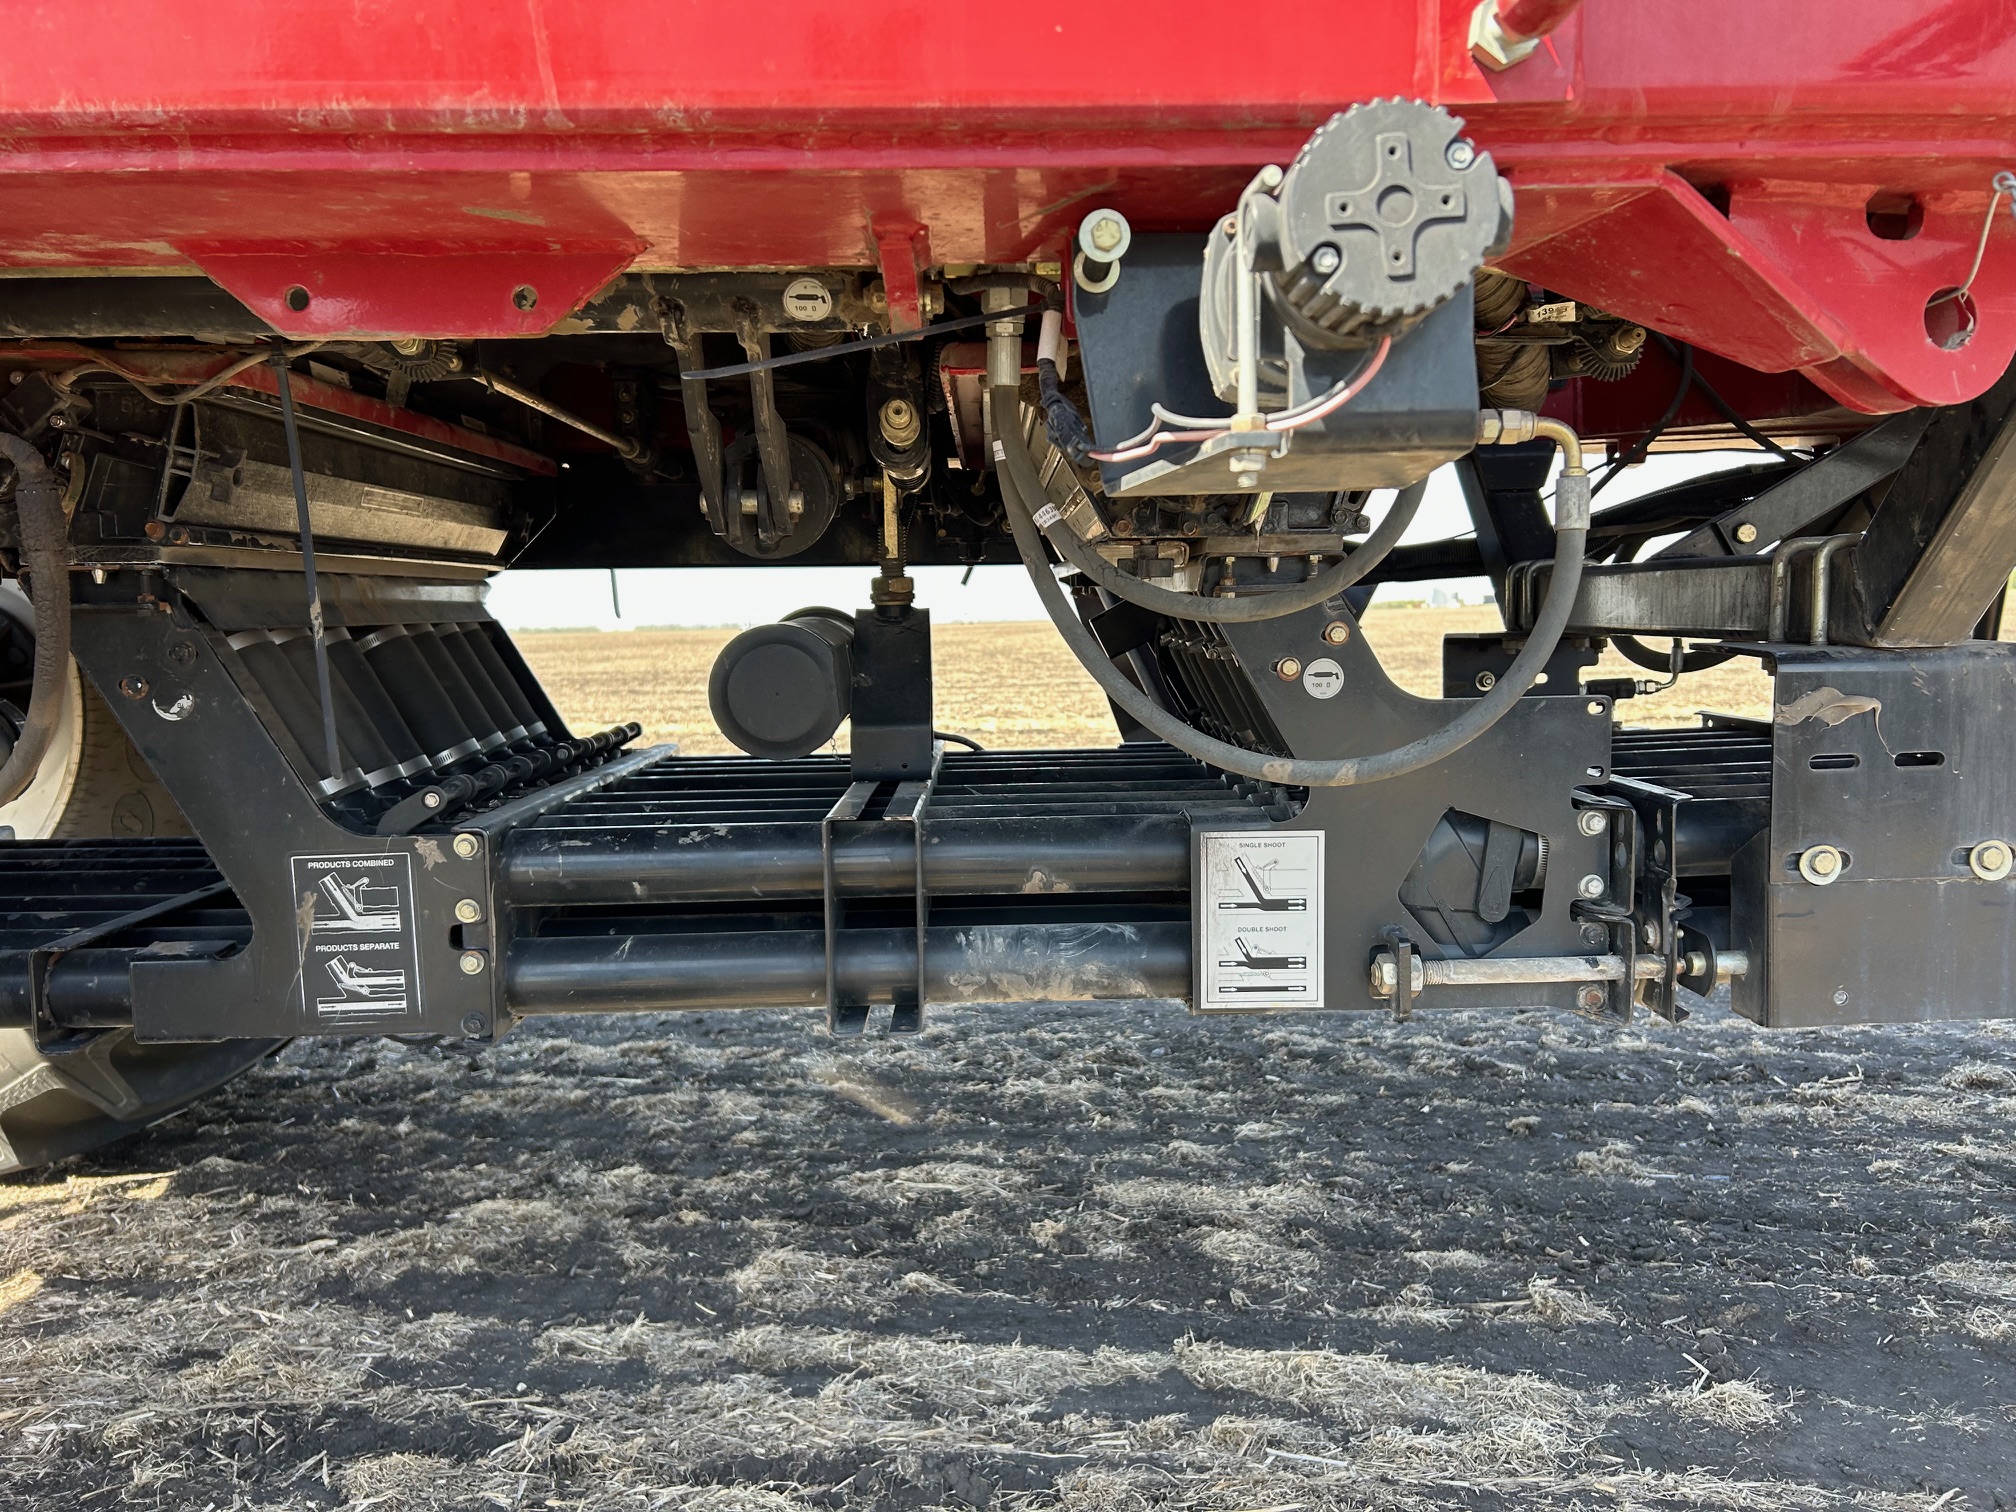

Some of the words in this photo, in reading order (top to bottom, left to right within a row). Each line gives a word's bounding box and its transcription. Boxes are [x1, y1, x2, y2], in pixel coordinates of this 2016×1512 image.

[308, 861, 351, 870] PRODUCTS
[352, 859, 394, 868] COMBINED
[315, 943, 358, 953] PRODUCTS
[359, 942, 400, 951] SEPARATE
